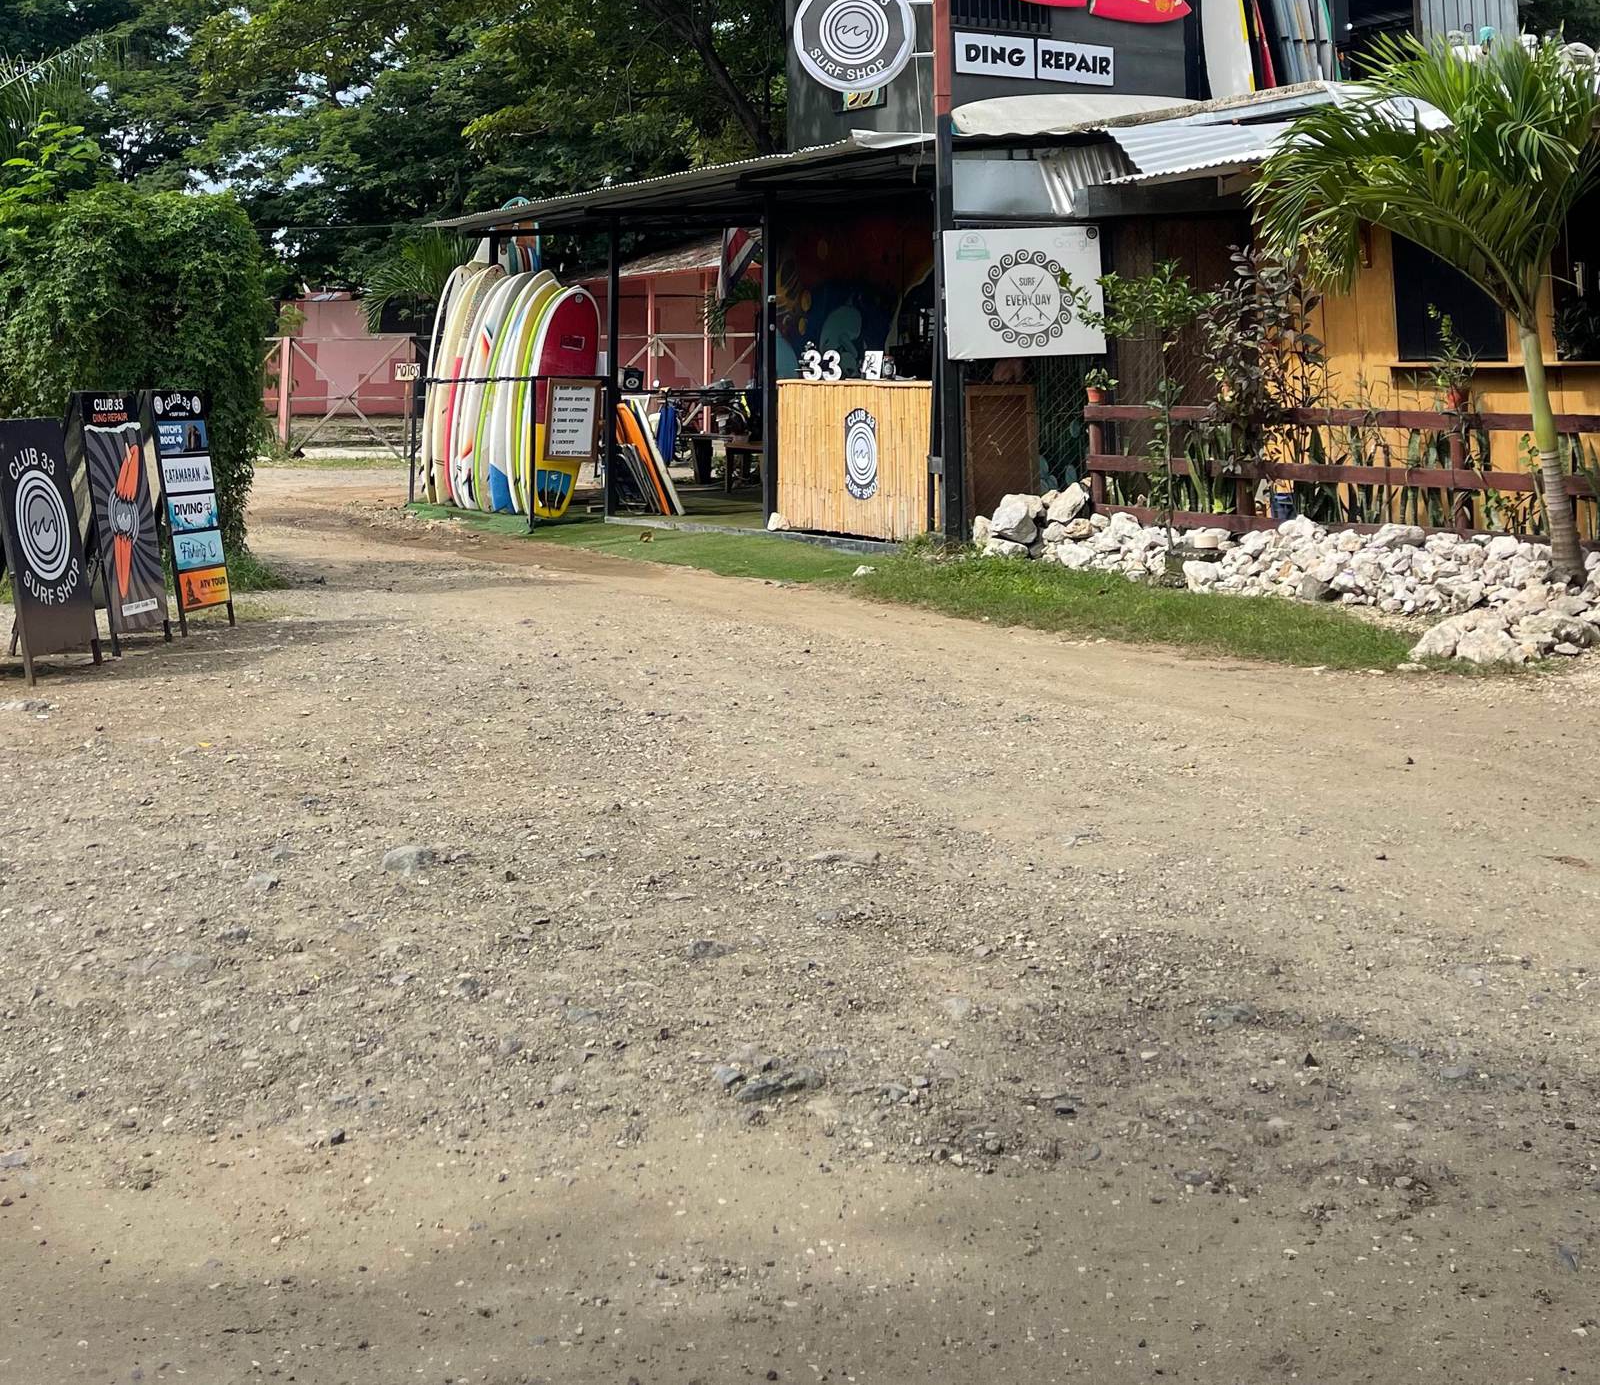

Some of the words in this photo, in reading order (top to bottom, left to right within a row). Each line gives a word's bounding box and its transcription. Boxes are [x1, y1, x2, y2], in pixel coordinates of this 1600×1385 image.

[810, 48, 844, 77] SURF
[846, 58, 885, 80] SHOP
[965, 43, 1025, 67] DING
[1041, 49, 1110, 75] REPAIR
[1019, 277, 1036, 286] SURF
[1005, 295, 1032, 307] EVERY
[1035, 294, 1051, 306] DAY
[395, 364, 420, 378] MOTOS
[803, 349, 842, 381] 33
[94, 399, 114, 411] CLUB
[113, 399, 124, 411] 33
[164, 394, 181, 411] CLUB
[181, 396, 191, 410] 33
[93, 414, 108, 423] DING
[108, 412, 129, 422] REPAIR
[847, 410, 866, 427] CLUB
[160, 436, 176, 445] ROCK
[9, 448, 38, 480] CLUB
[41, 453, 55, 476] 33
[164, 467, 201, 483] CATAMARAN
[845, 475, 862, 497] SURF
[174, 502, 203, 515] DIVING
[180, 541, 206, 561] Fishing
[23, 570, 54, 605] SURF
[56, 557, 80, 604] SHOP
[200, 579, 211, 588] ATV
[211, 577, 226, 586] TOUR
